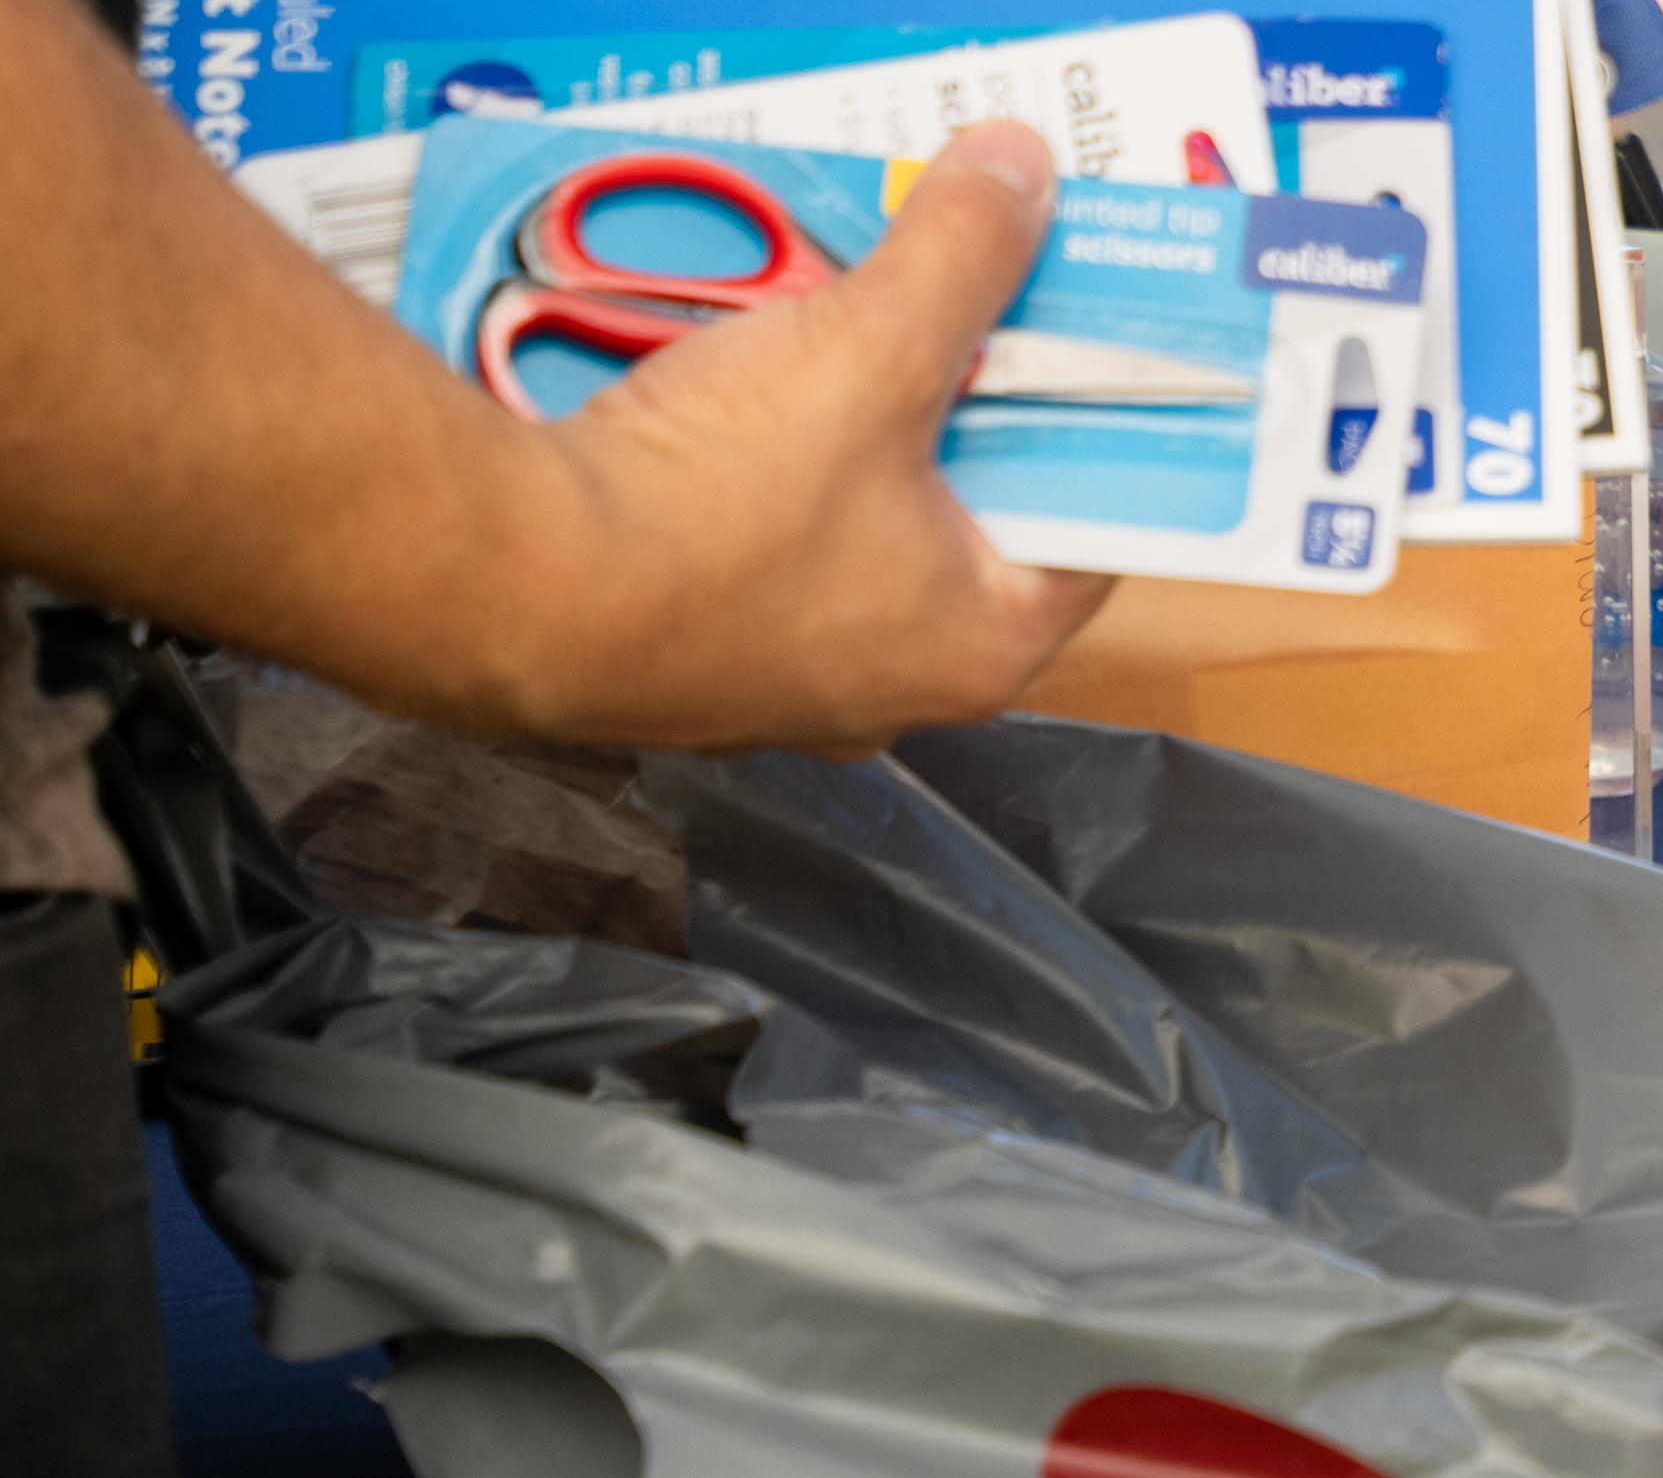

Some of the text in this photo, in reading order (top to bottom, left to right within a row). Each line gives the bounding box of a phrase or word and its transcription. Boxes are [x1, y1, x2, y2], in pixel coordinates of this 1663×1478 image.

[1061, 230, 1219, 275] scissors
[1257, 242, 1392, 293] caliber
[1464, 410, 1536, 497] 70
